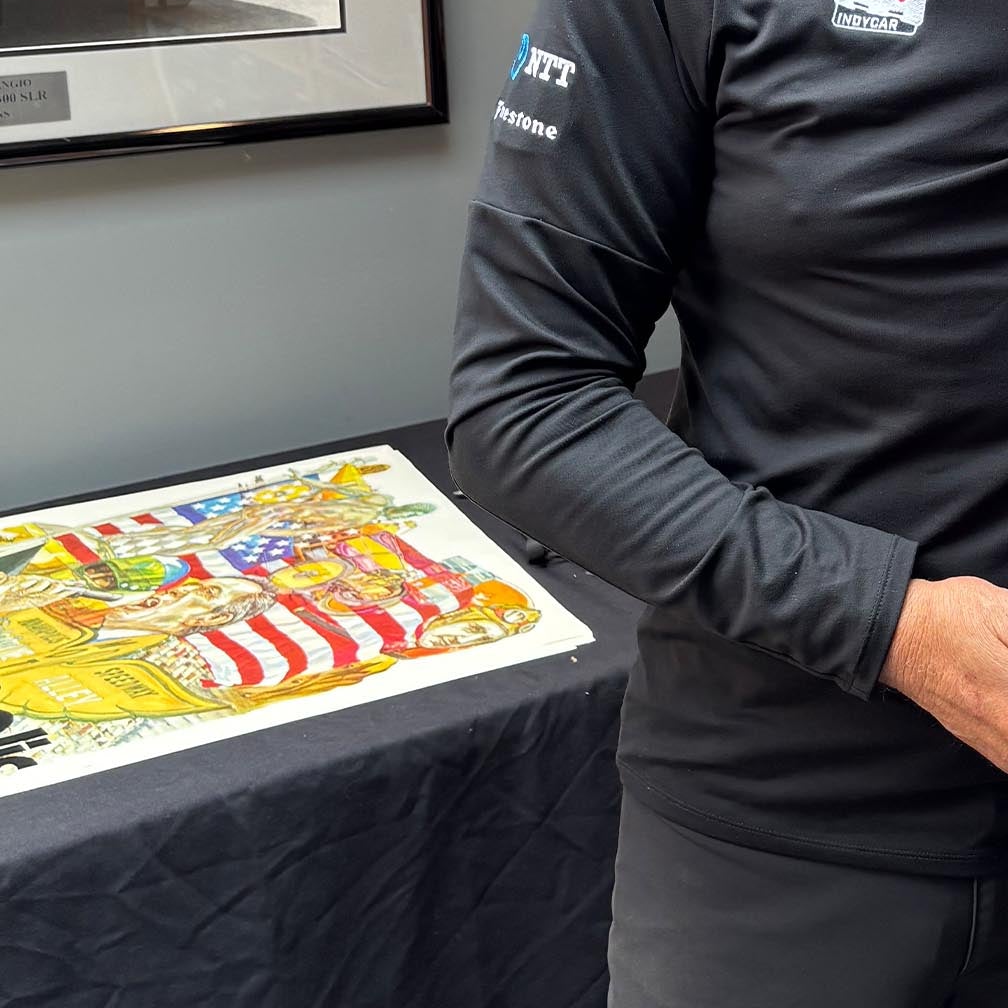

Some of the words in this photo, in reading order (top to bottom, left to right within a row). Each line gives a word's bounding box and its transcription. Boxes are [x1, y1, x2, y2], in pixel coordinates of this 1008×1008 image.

[837, 12, 899, 31] INDYCAR
[524, 46, 576, 88] NTT
[20, 90, 48, 101] SLR
